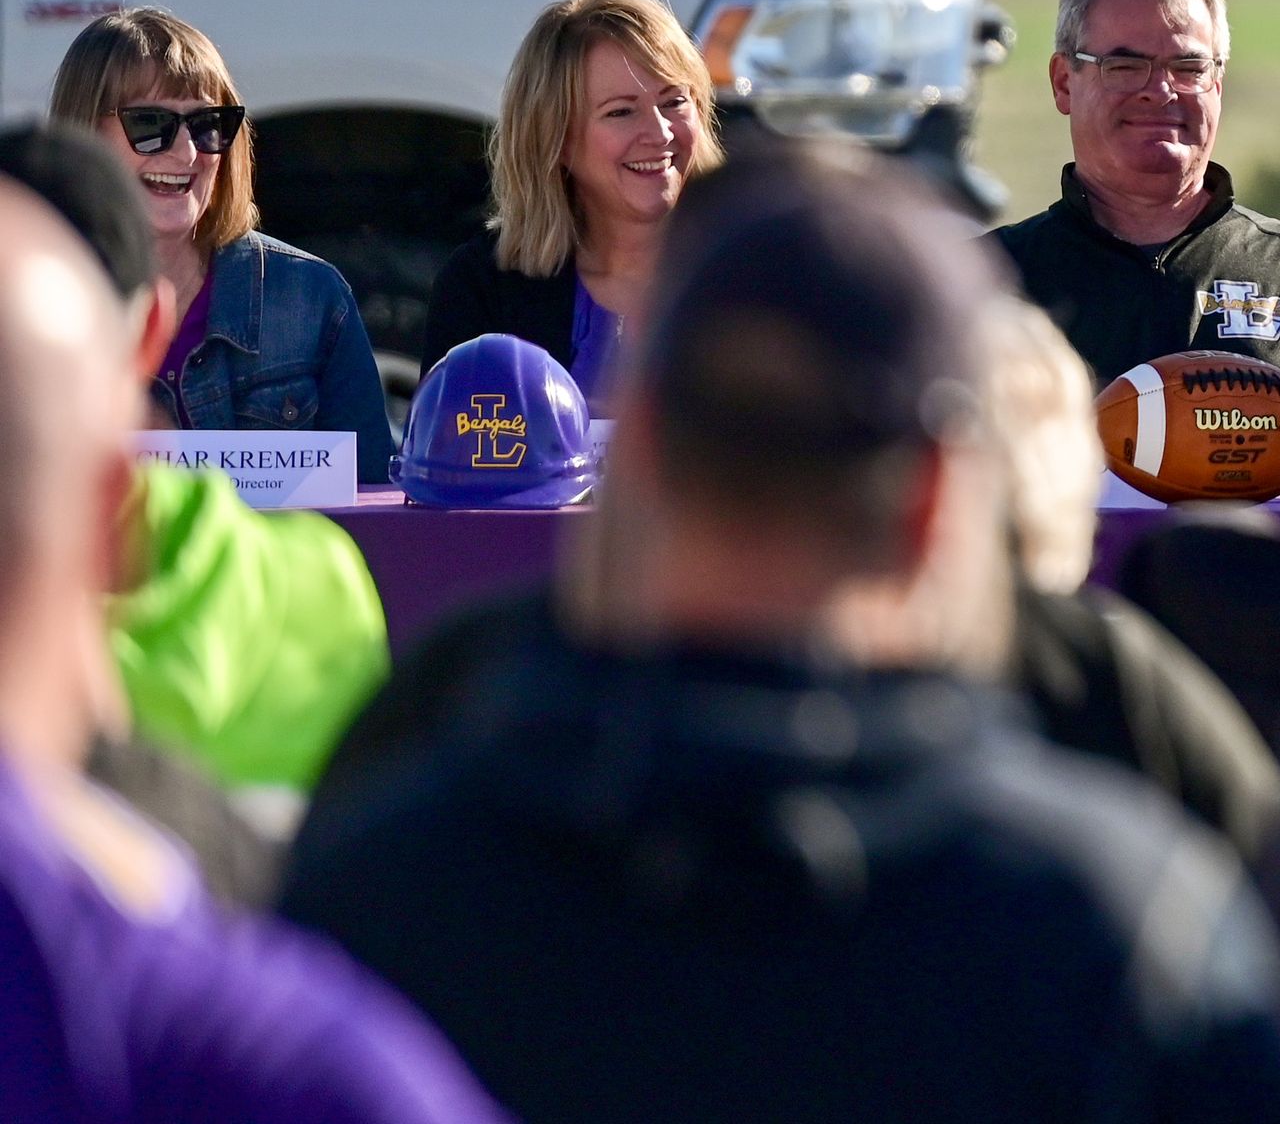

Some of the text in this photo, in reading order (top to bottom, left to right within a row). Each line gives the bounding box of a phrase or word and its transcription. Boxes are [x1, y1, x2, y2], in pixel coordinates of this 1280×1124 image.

[456, 412, 527, 440] Bengals
[1194, 408, 1278, 430] Wilson
[471, 394, 527, 468] L
[220, 449, 333, 469] KREMER
[1208, 448, 1268, 464] GST
[230, 477, 284, 490] Director
